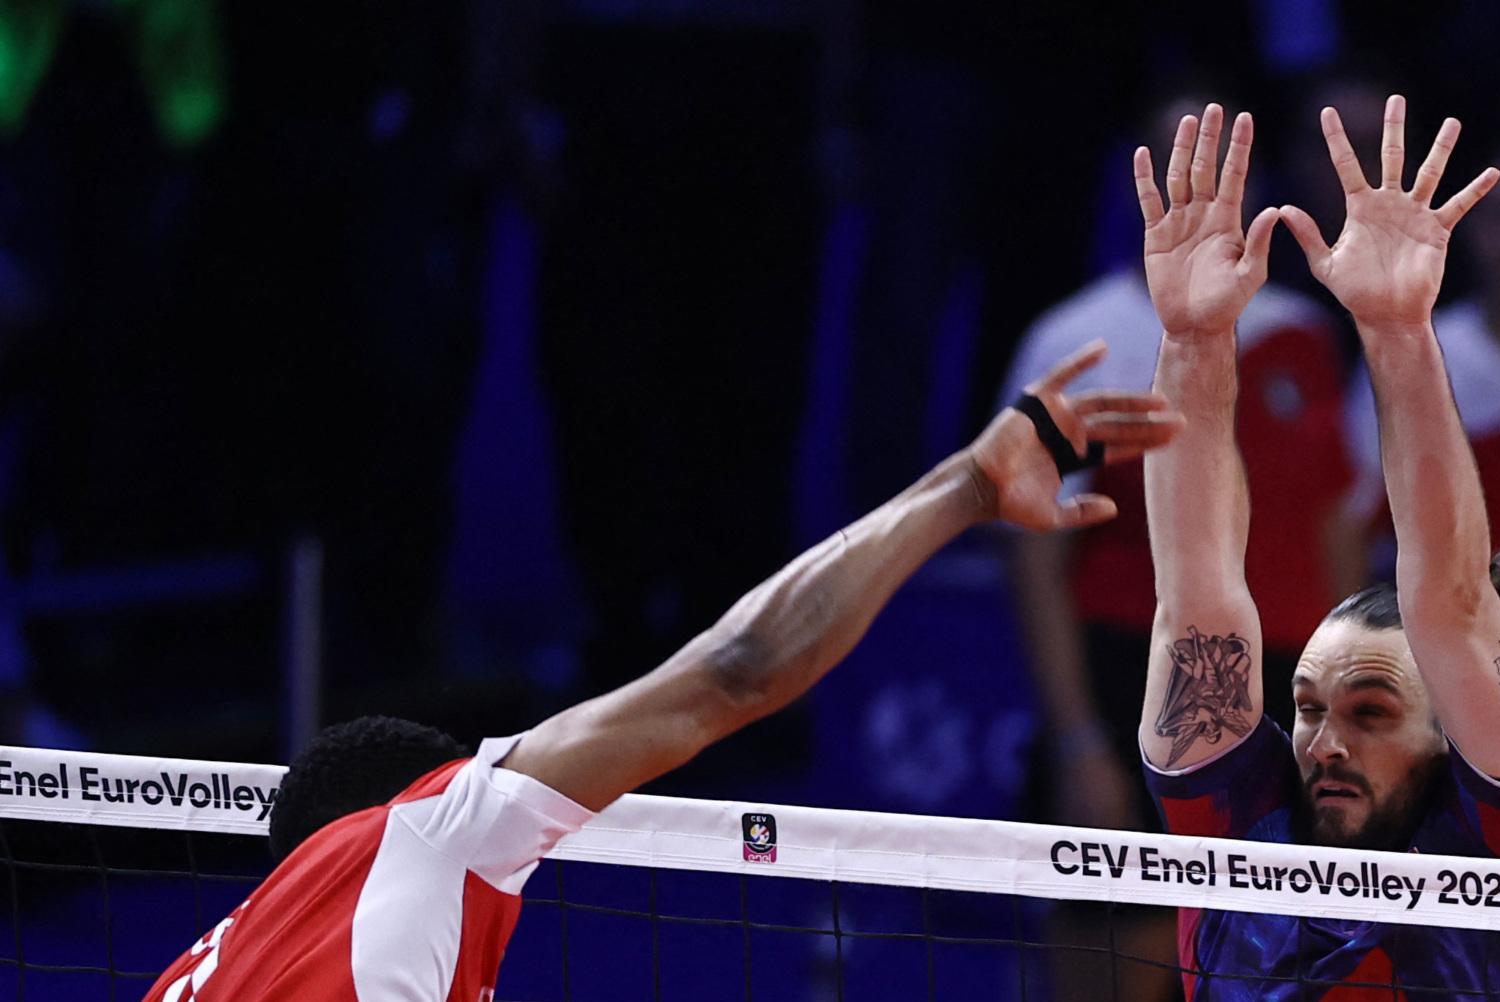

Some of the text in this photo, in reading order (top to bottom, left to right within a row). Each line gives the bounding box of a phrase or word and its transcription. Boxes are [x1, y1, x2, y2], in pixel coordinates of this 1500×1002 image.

[0, 760, 278, 821] Enel EuroVolley
[1050, 840, 1129, 880] CEV
[1140, 846, 1217, 887] Enel
[1228, 853, 1426, 910] EuroVolley
